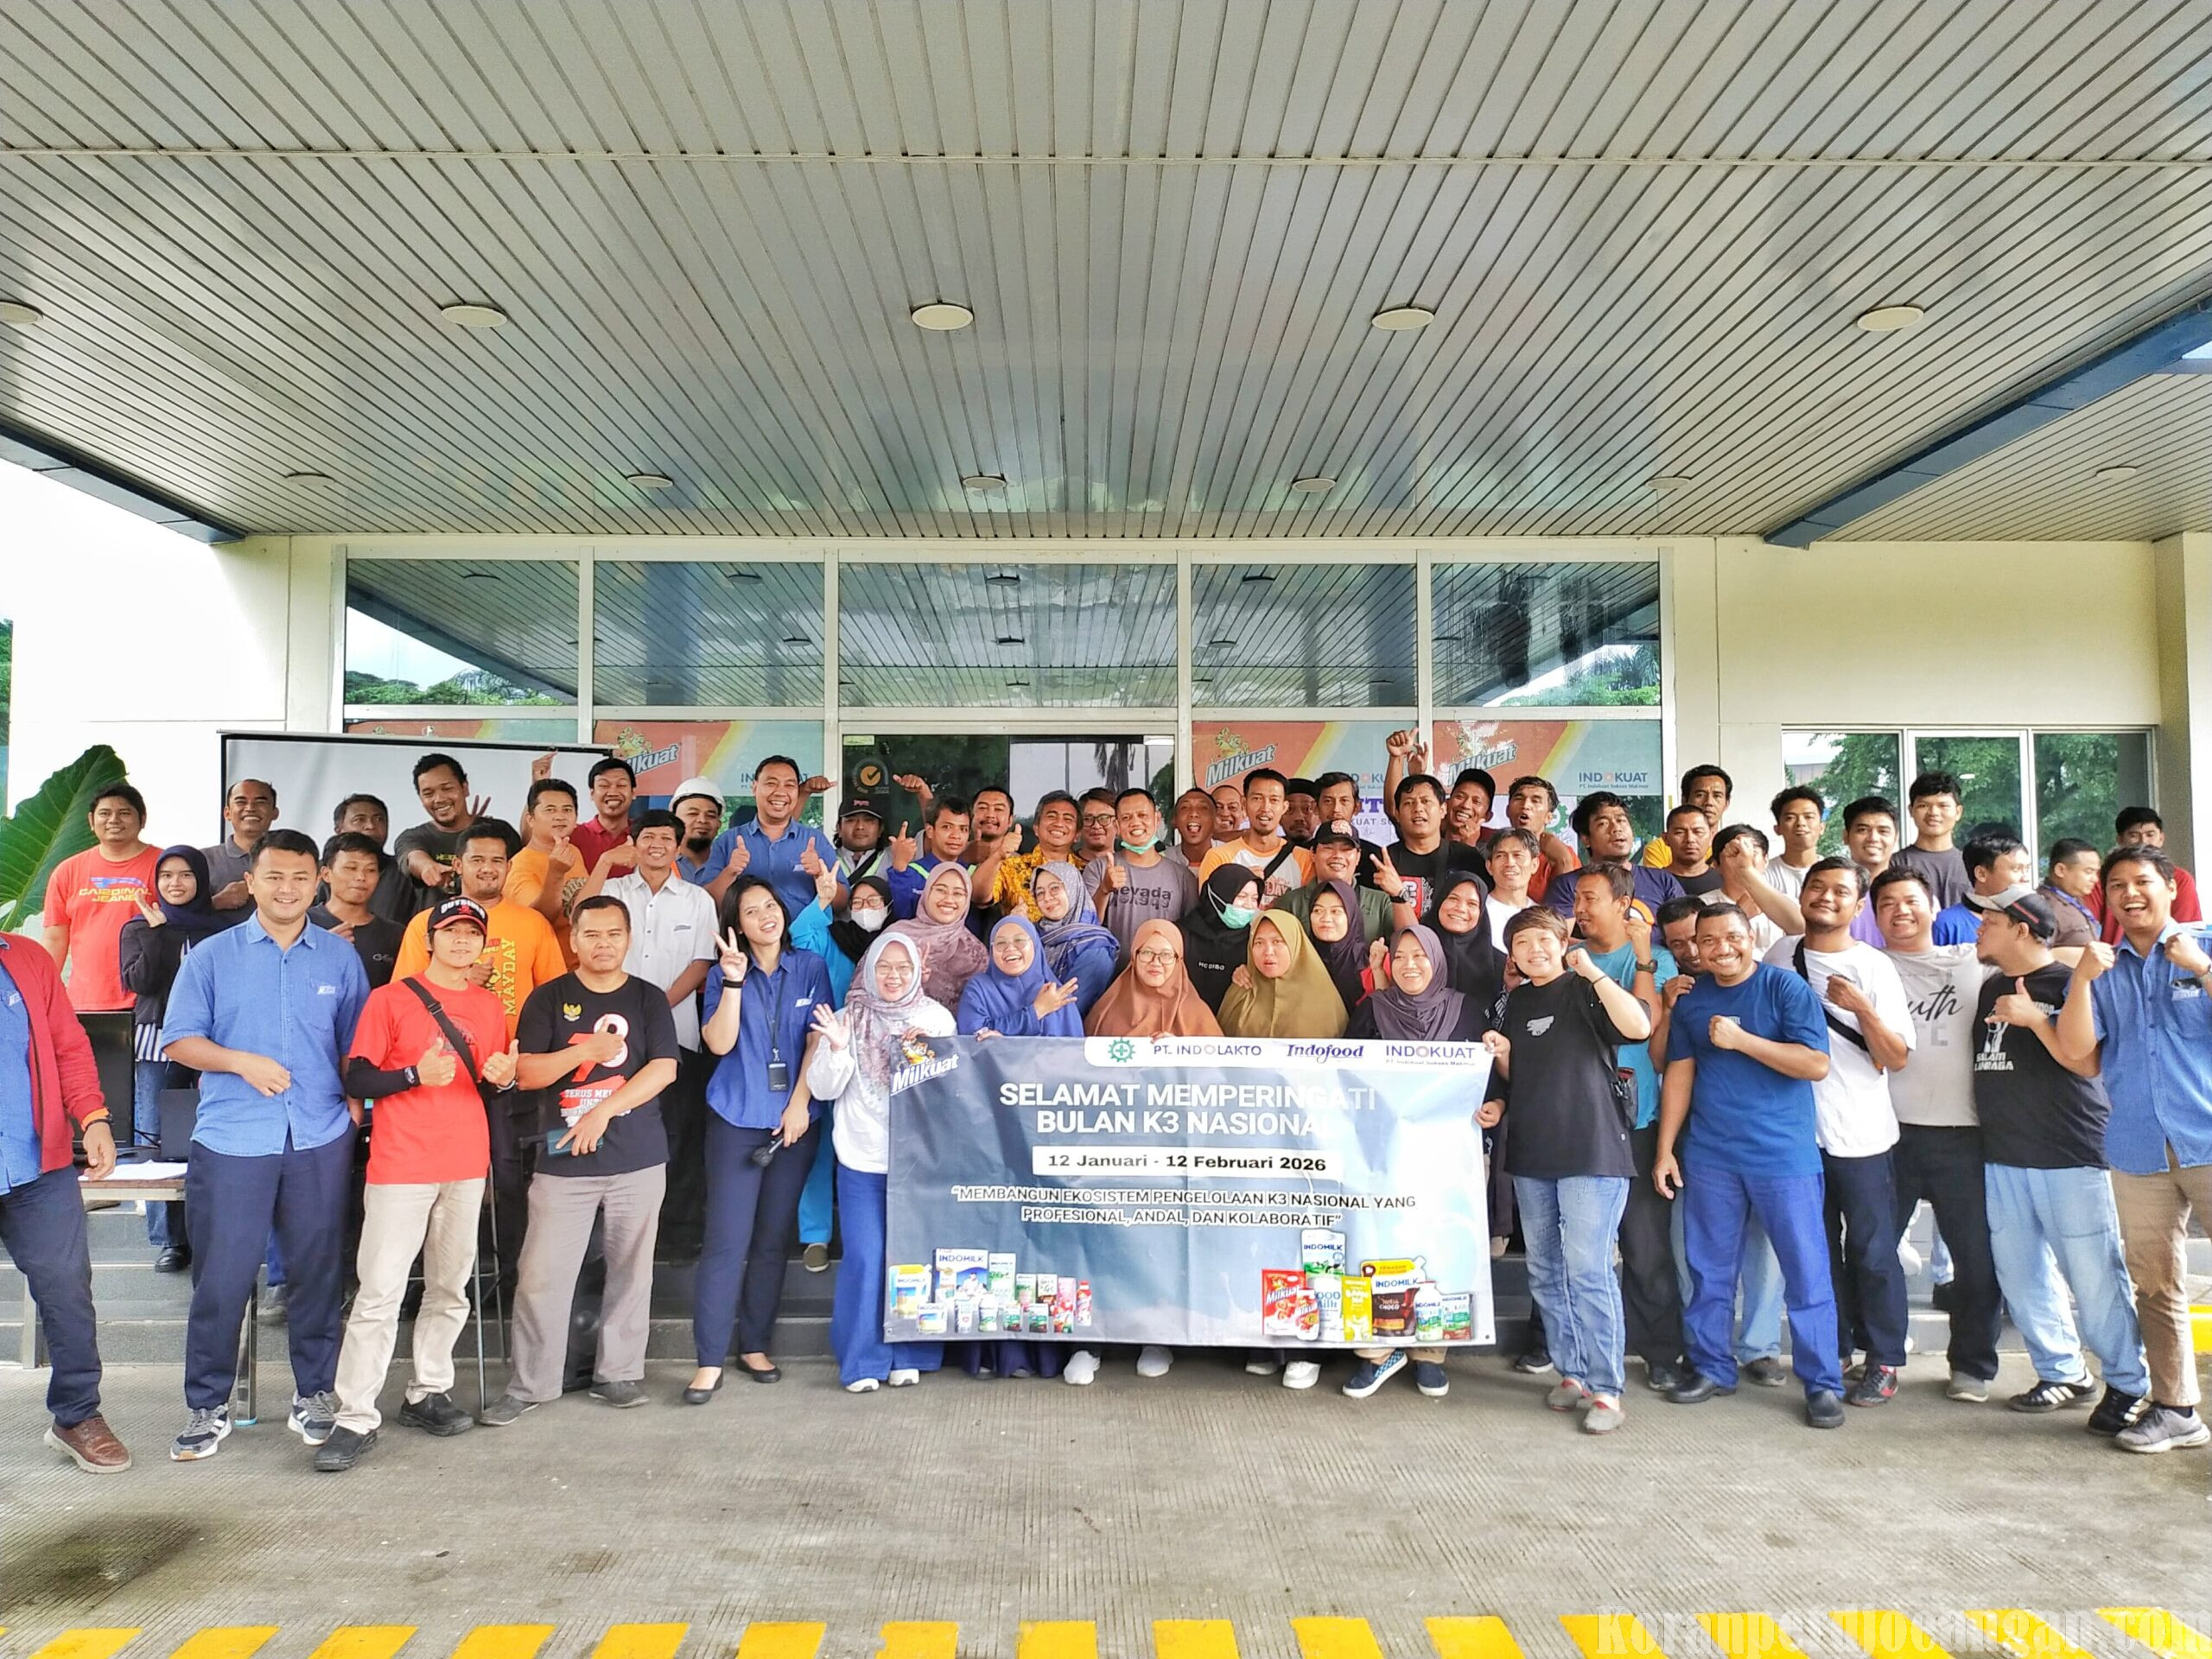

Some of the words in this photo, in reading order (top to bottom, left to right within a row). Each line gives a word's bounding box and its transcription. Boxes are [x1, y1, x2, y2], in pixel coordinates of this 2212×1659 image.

[626, 744, 679, 775] ilkuat
[1205, 744, 1275, 788] Milkuat
[501, 938, 516, 1015] MAYDAY
[1176, 1045, 1262, 1057] INDOLAKTO
[1287, 1044, 1363, 1064] Indofood
[1385, 1045, 1476, 1058] INDOKUAT
[891, 1052, 959, 1094] Milkuat
[1000, 1083, 1141, 1107] SELAMAT
[1147, 1084, 1376, 1111] MEMPERINGATI
[1037, 1110, 1135, 1134] BULAN
[1142, 1110, 1179, 1134] K3
[1186, 1112, 1325, 1137] NASIONA
[1048, 1154, 1070, 1166] 12
[1076, 1154, 1147, 1167] Januari
[1166, 1154, 1188, 1167] 12
[1194, 1155, 1273, 1169] Februari
[1280, 1157, 1326, 1171] 2026
[1063, 1190, 1149, 1203] EKOSISTEM
[1153, 1191, 1263, 1205] PENGELOLAAN
[1268, 1193, 1287, 1205] K3
[1291, 1194, 1370, 1209] NASIONAL
[1374, 1196, 1416, 1209] YANG
[1022, 1207, 1129, 1224] PROFESIONAL,
[1134, 1209, 1189, 1225] ANDAL,
[1192, 1211, 1224, 1224] DAN
[1375, 1277, 1419, 1287] INDOMILK
